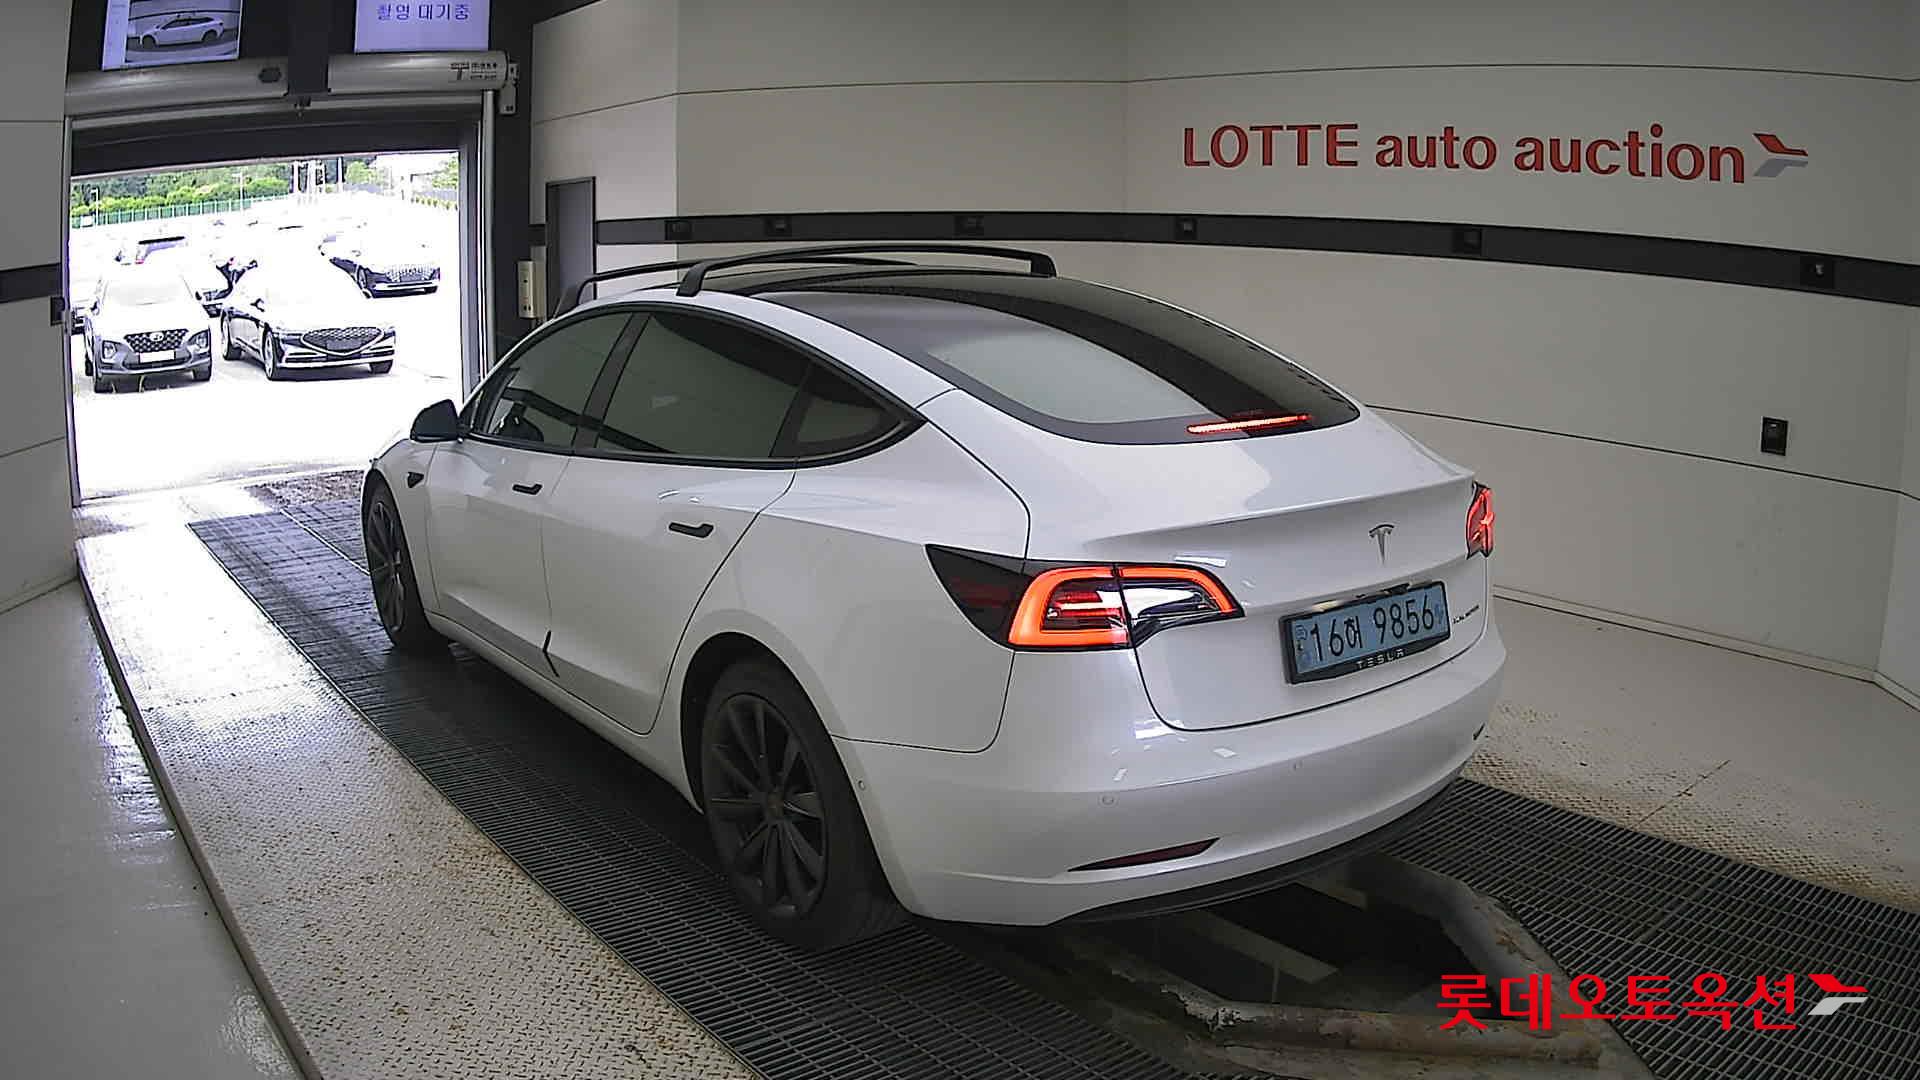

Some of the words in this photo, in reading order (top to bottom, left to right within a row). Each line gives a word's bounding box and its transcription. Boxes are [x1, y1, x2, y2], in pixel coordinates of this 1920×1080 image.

[418, 4, 469, 21] 대기중
[1183, 122, 1361, 169] LOTTE
[1375, 126, 1499, 171] auto
[1513, 122, 1745, 184] auction
[1310, 615, 1363, 662] 16허
[1373, 594, 1434, 645] 9856
[1357, 648, 1405, 669] TESLA
